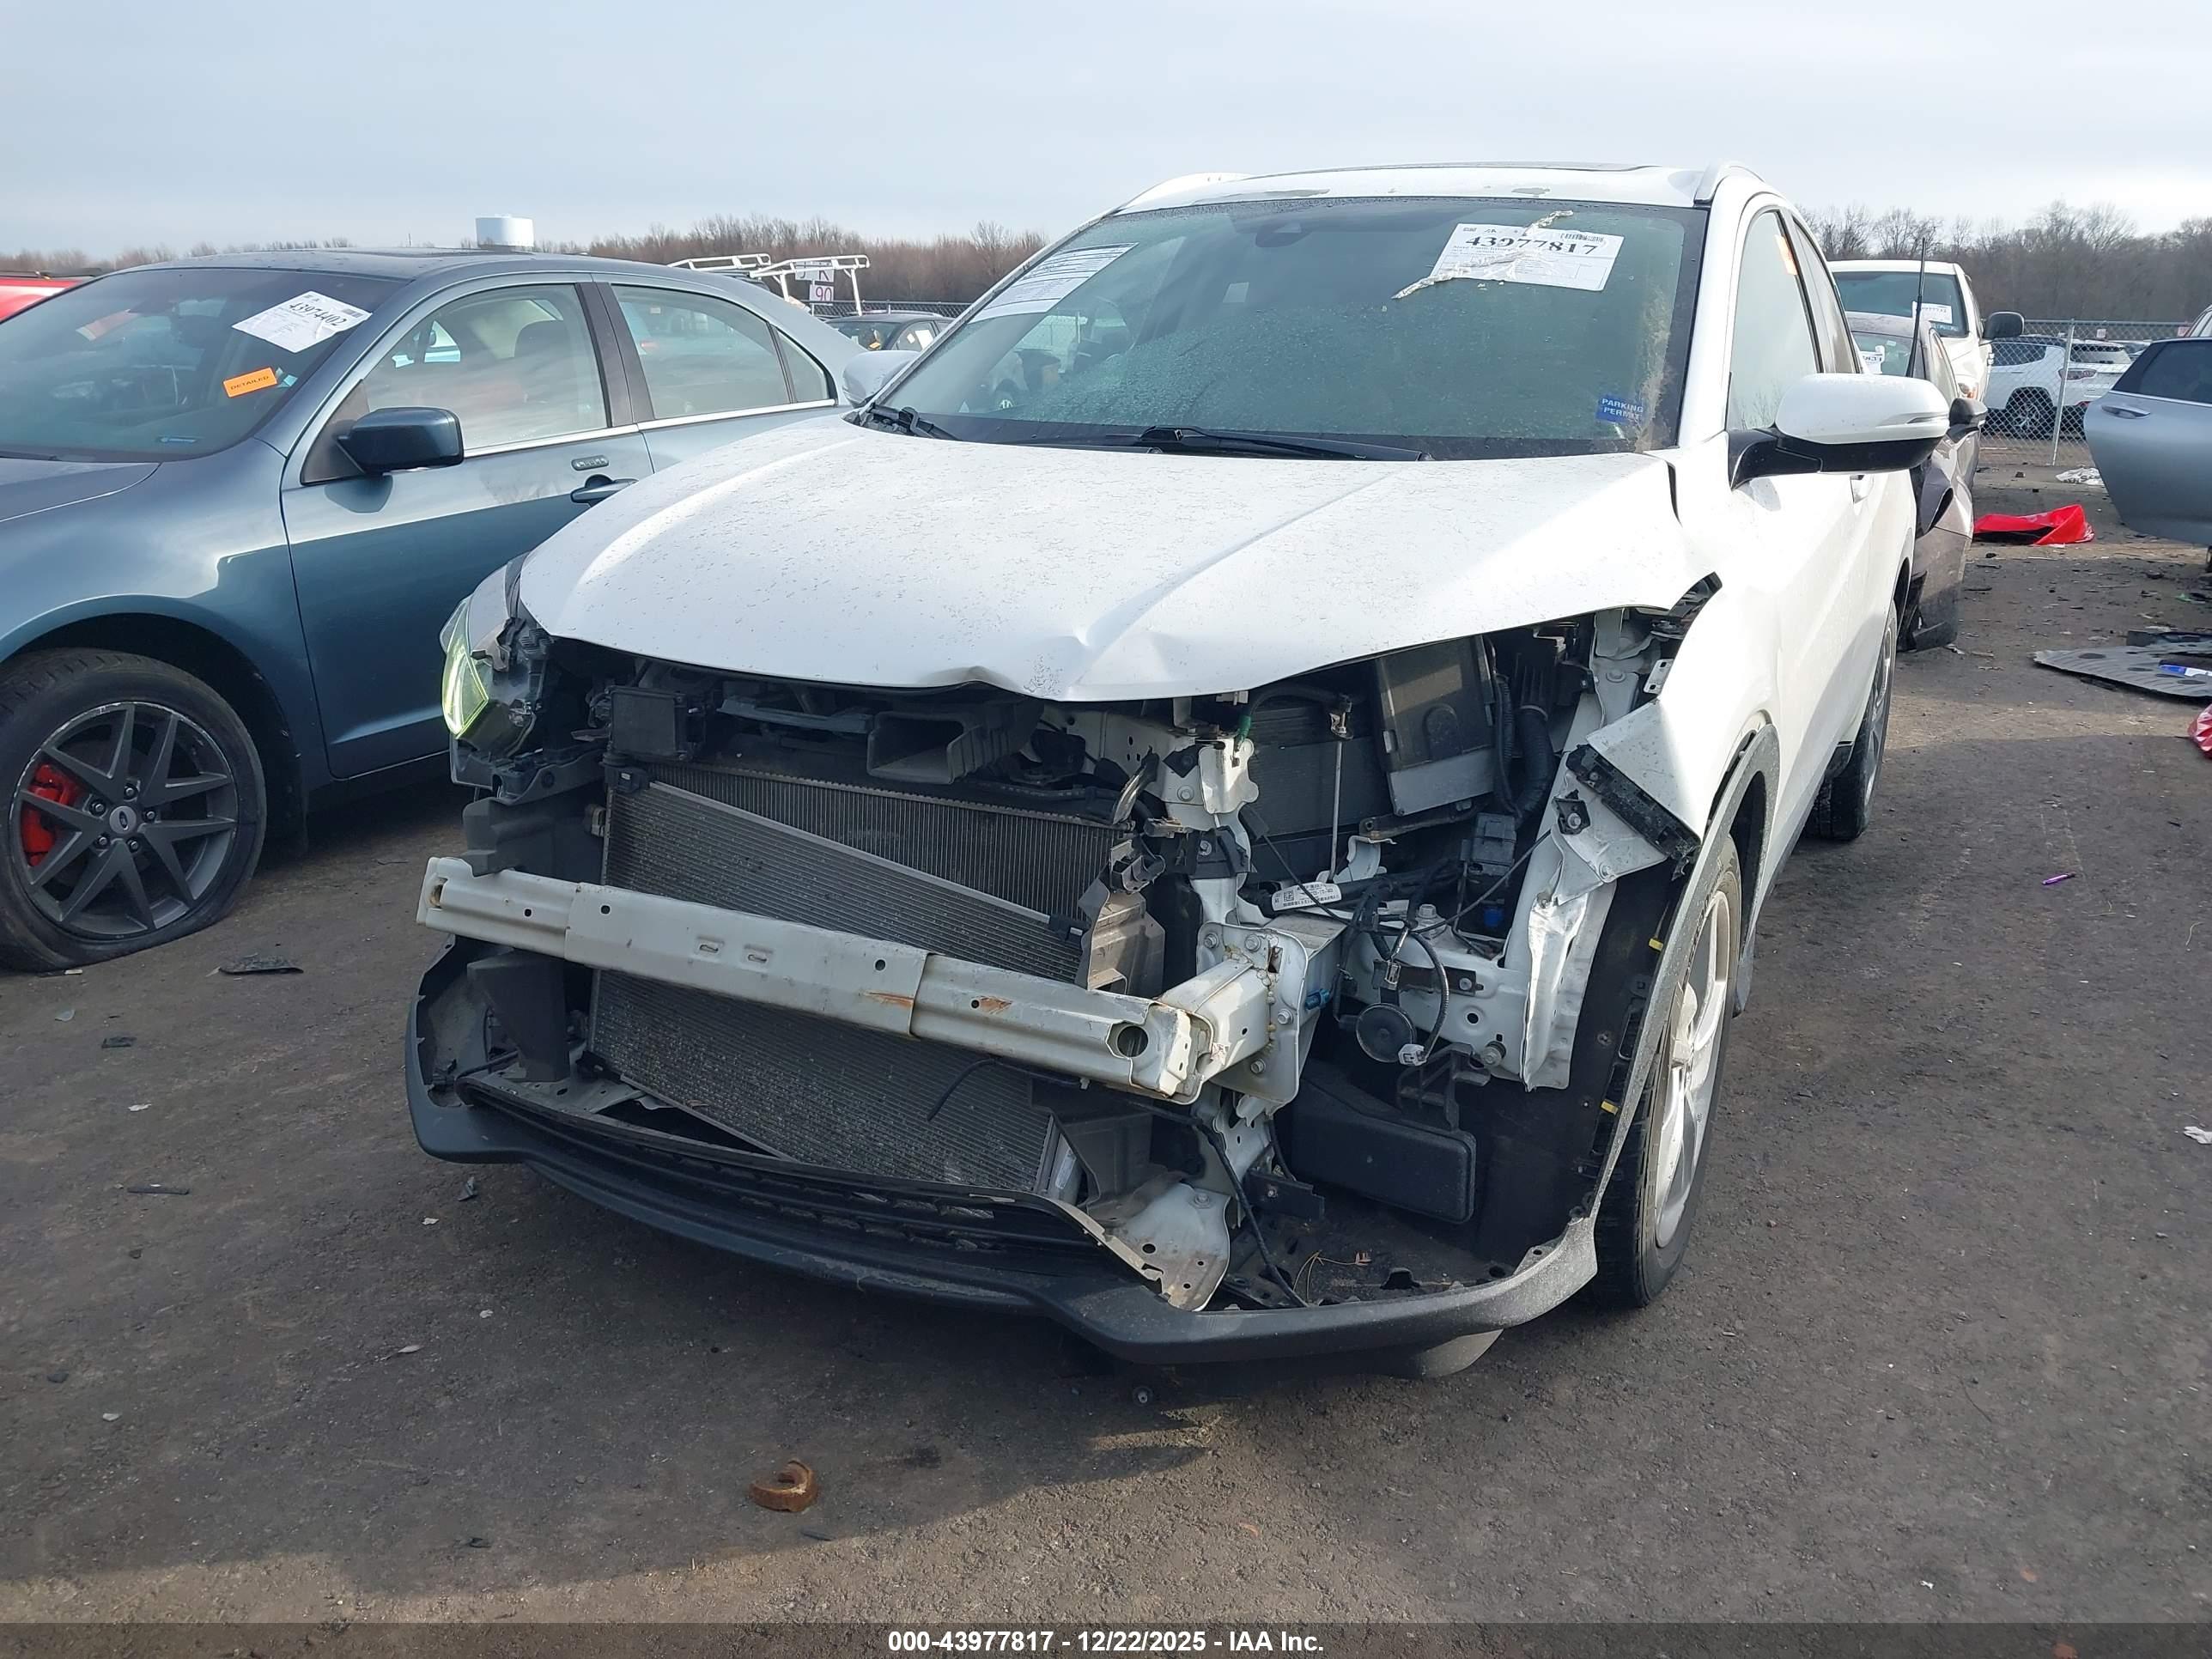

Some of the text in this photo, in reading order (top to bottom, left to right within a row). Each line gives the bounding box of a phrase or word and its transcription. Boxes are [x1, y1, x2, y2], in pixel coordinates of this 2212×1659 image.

[1465, 235, 1598, 255] 43977817
[815, 287, 832, 301] 90
[289, 301, 348, 326] 43974402
[230, 375, 269, 390] DETAILED
[1601, 398, 1644, 413] PARKING
[1603, 406, 1643, 420] PERMIT
